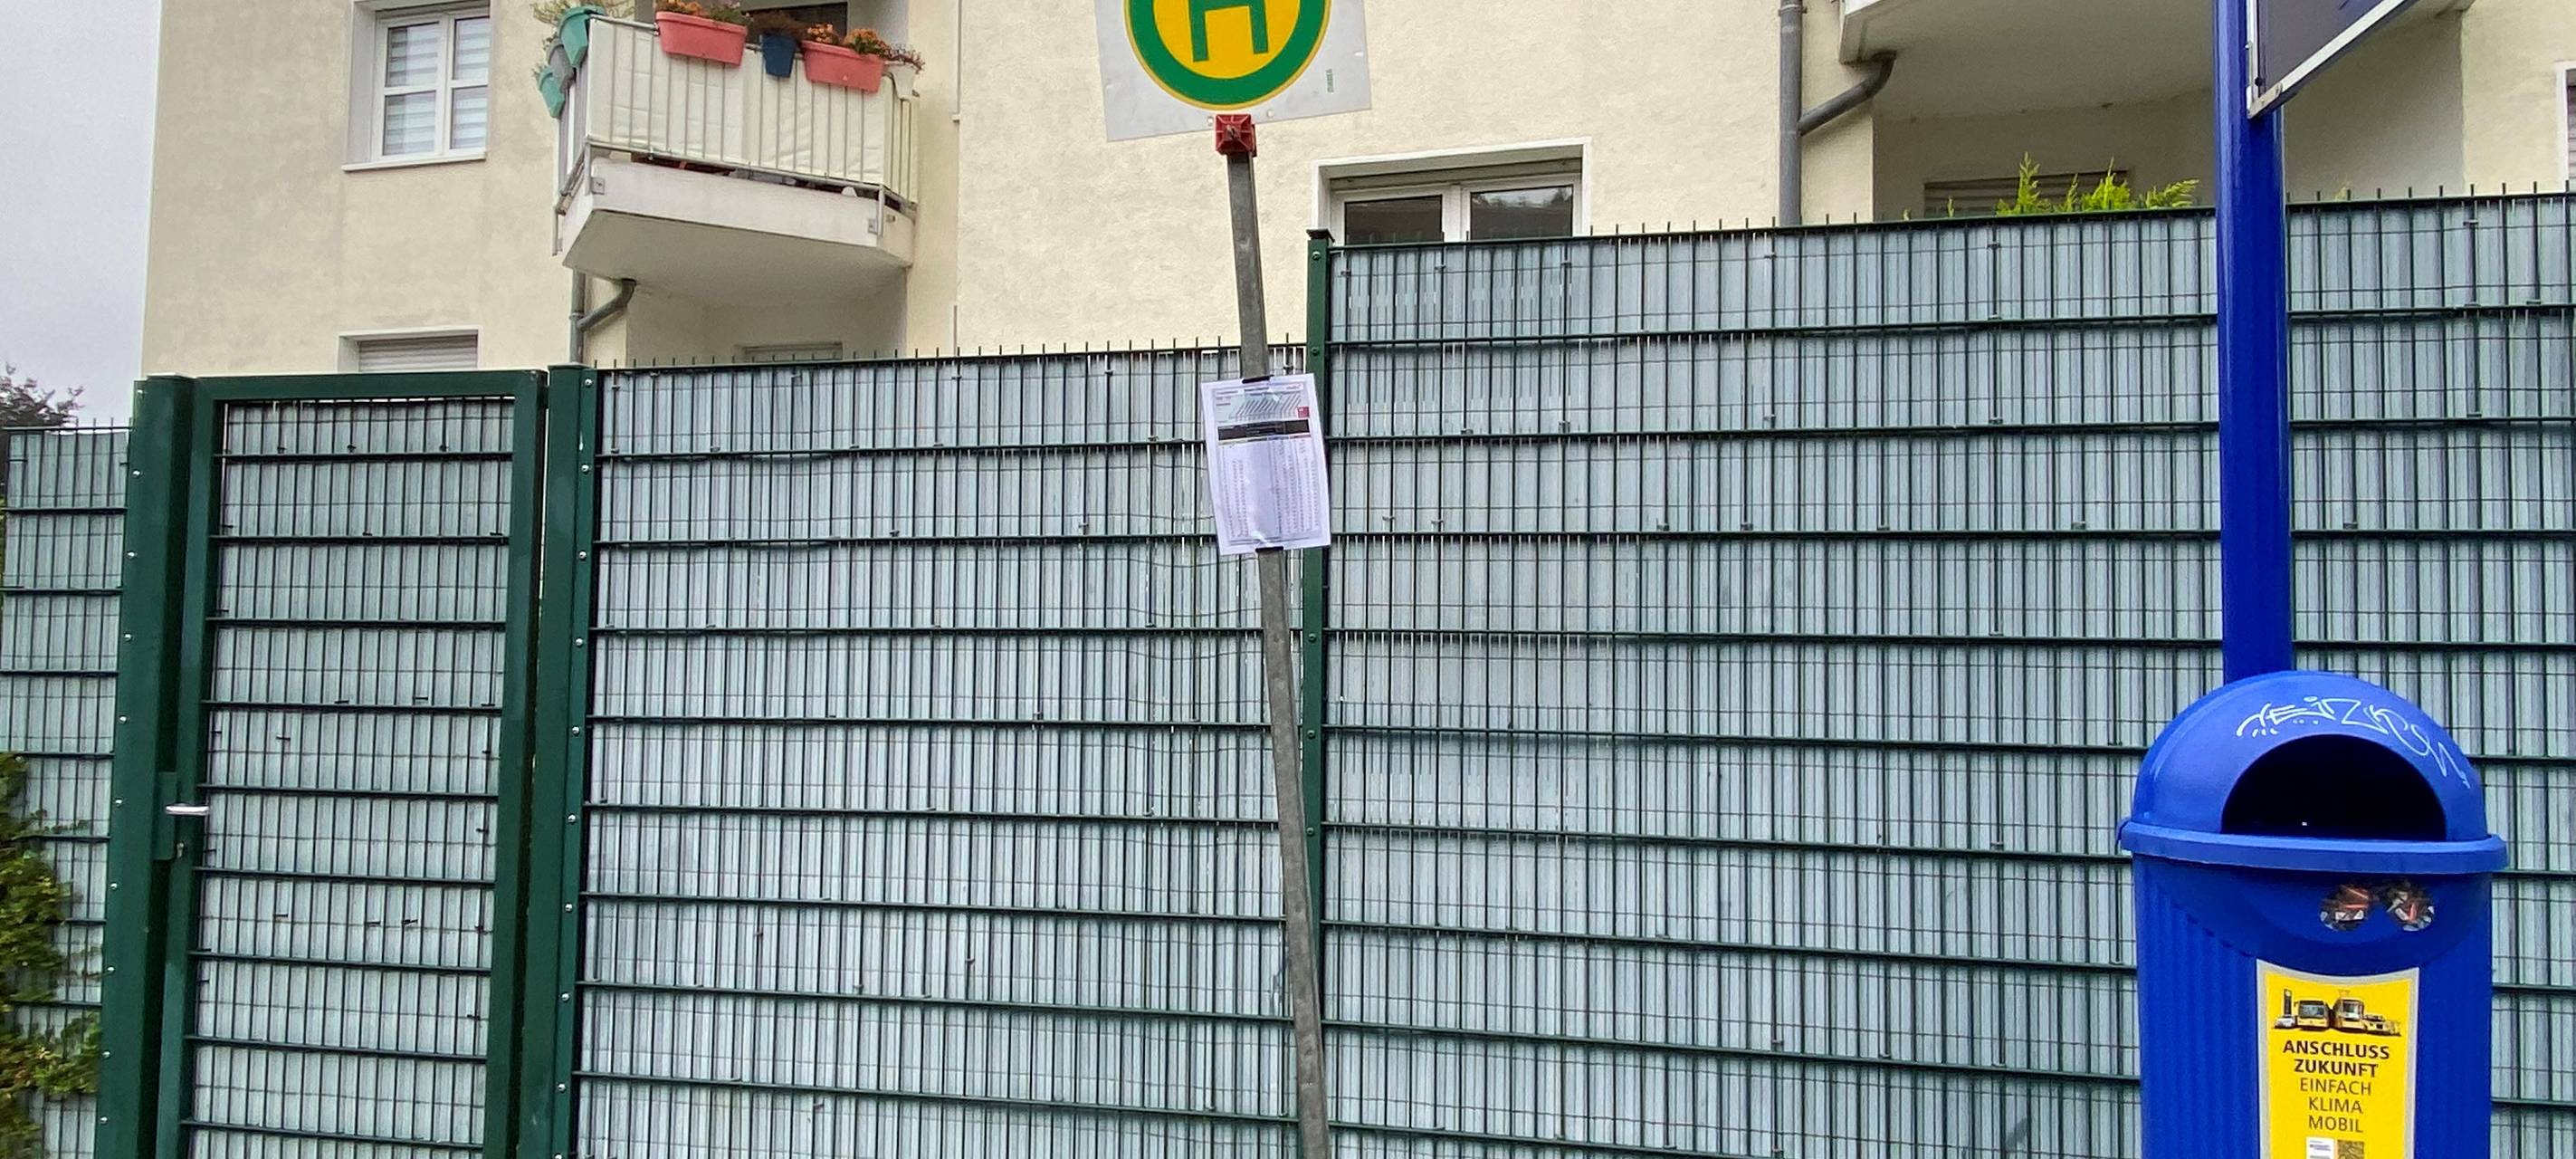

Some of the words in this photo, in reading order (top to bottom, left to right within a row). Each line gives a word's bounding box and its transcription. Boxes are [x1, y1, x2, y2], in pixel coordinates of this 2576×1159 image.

[2283, 1039, 2390, 1059] ANSCHLUSS
[2294, 1059, 2378, 1078] ZUKUNFT
[2300, 1078, 2371, 1096] EINFACH
[2308, 1097, 2362, 1114] KLIMA
[2308, 1116, 2363, 1133] MOBIL
